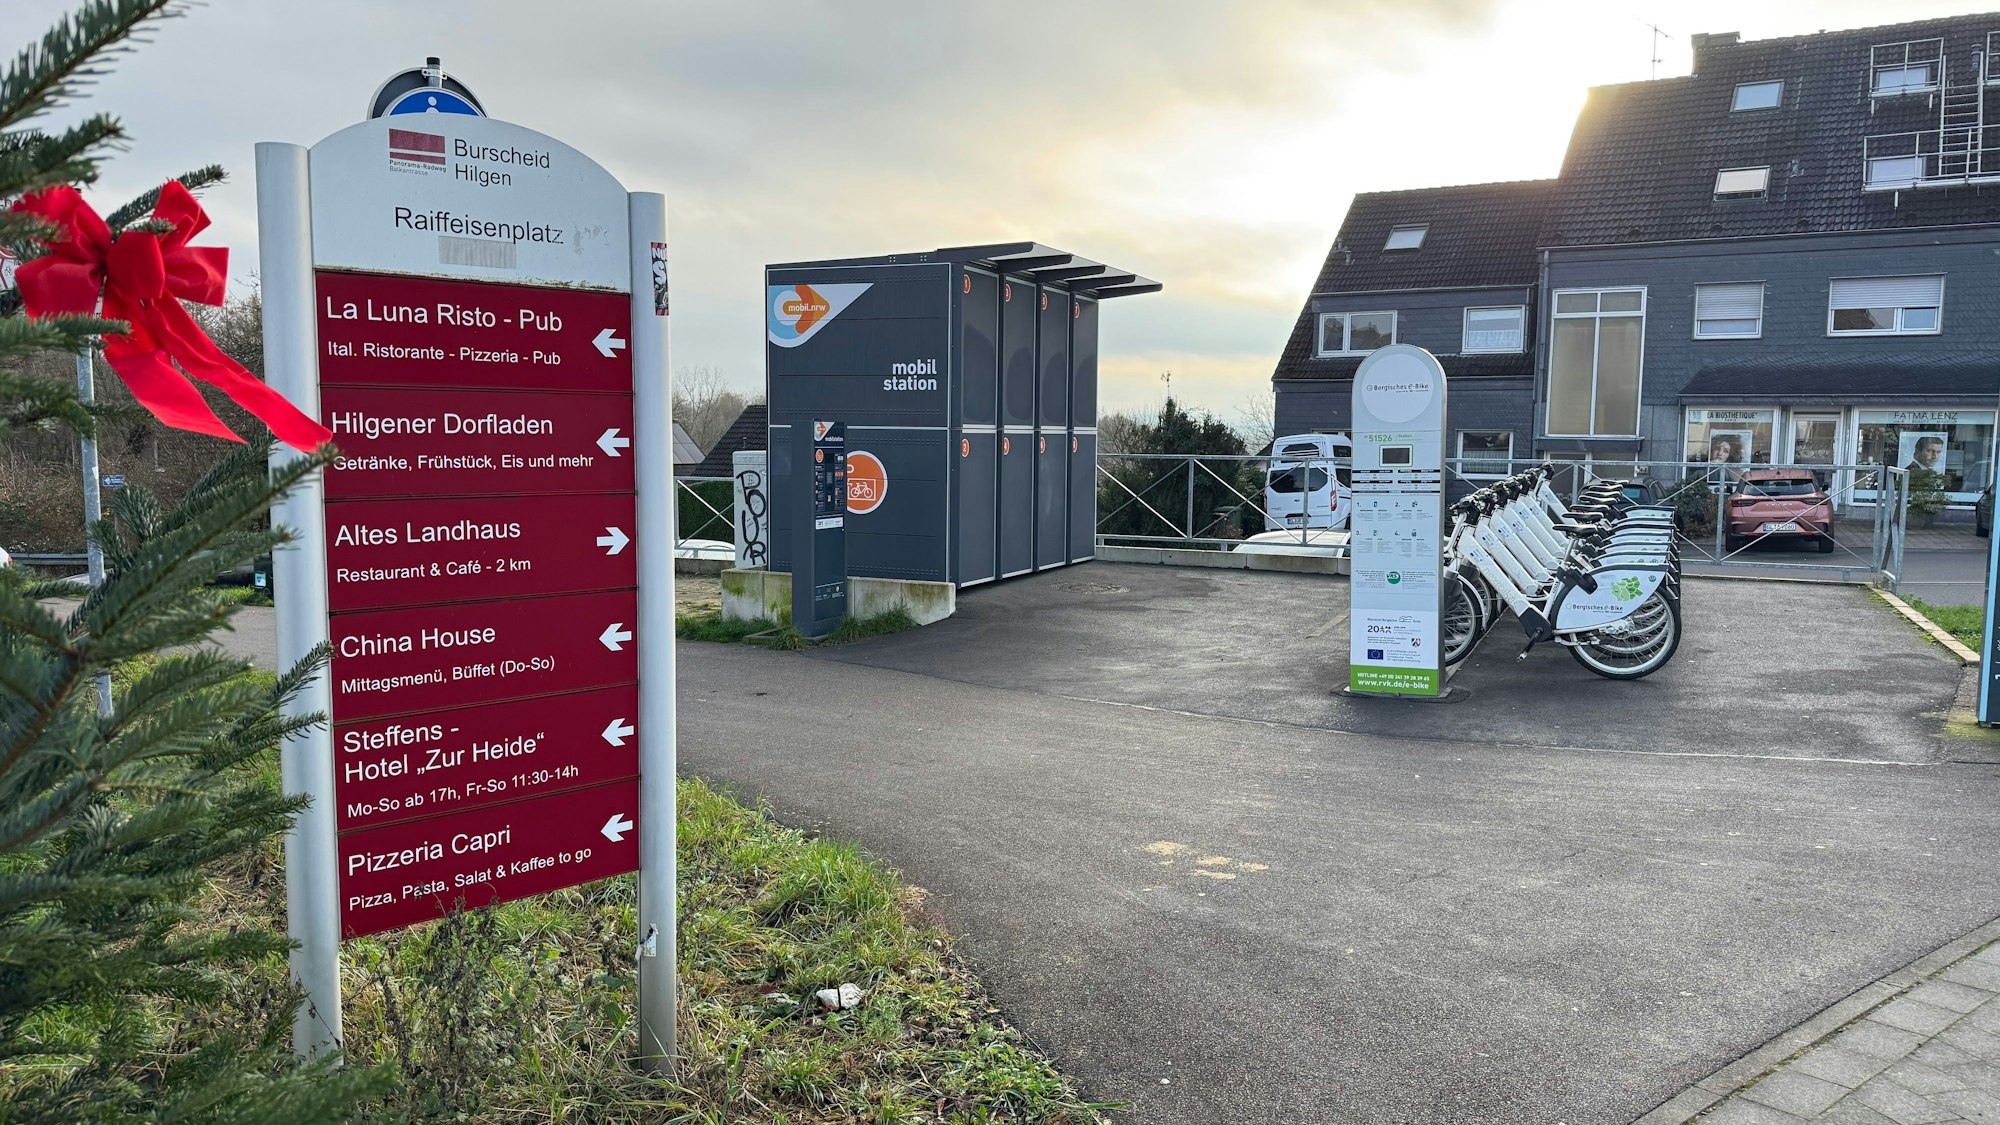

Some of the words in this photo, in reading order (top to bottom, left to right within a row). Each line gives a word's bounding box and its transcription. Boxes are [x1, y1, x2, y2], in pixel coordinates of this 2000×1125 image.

[454, 138, 550, 169] Burscheid
[389, 160, 447, 173] Panorama-Radweg
[389, 166, 428, 177] Balkantrasse
[456, 163, 512, 187] Hilgen
[395, 206, 564, 245] Raiffeisenplatz
[327, 296, 358, 320] La
[368, 299, 429, 324] Luna
[437, 304, 496, 328] Risto
[519, 309, 562, 332] Pub
[788, 304, 826, 312] mobil.nrw
[328, 341, 358, 357] Ital.
[364, 343, 445, 360] Ristorante
[460, 347, 519, 364] Pizzeria
[533, 351, 561, 365] Pub
[892, 359, 937, 375] mobil
[883, 375, 937, 391] station
[1374, 384, 1407, 392] Bergisches
[332, 412, 435, 440] Hilgener
[444, 413, 553, 435] Dorfladen
[1894, 412, 1929, 420] FATMA
[1932, 412, 1958, 420] LENZ
[1369, 434, 1393, 443] 51526
[333, 456, 413, 472] Getränke,
[418, 455, 497, 471] Frühstück,
[502, 454, 524, 468] Eis
[528, 455, 554, 468] und
[559, 455, 594, 468] mehr
[335, 524, 398, 547] Altes
[406, 520, 521, 544] Landhaus
[337, 563, 425, 583] Restaurant
[430, 563, 441, 577] &
[446, 560, 481, 576] Café
[496, 559, 505, 572] 2
[510, 558, 532, 572] km
[340, 632, 413, 658] China
[422, 627, 497, 650] House
[342, 670, 447, 694] Mittagsmenü,
[453, 662, 496, 681] Büffet
[500, 656, 555, 677] (Do-So)
[1358, 680, 1429, 690] www.rvk.de/e-bike
[344, 724, 443, 753] Steffens
[345, 755, 409, 784] Hotel
[417, 749, 465, 775] „Zur
[348, 797, 400, 818] Mo-So
[405, 793, 424, 808] ab
[429, 787, 461, 803] 17h,
[466, 779, 507, 798] Fr-So
[512, 765, 579, 789] 11:30-14h
[348, 841, 443, 877] Pizzeria
[451, 826, 512, 857] Capri
[349, 891, 397, 911] Pizza,
[402, 880, 449, 900] Pasta,
[455, 868, 493, 887] Salat
[496, 865, 507, 878] &
[511, 856, 555, 875] Kaffee
[559, 851, 572, 864] to
[576, 847, 592, 865] go
